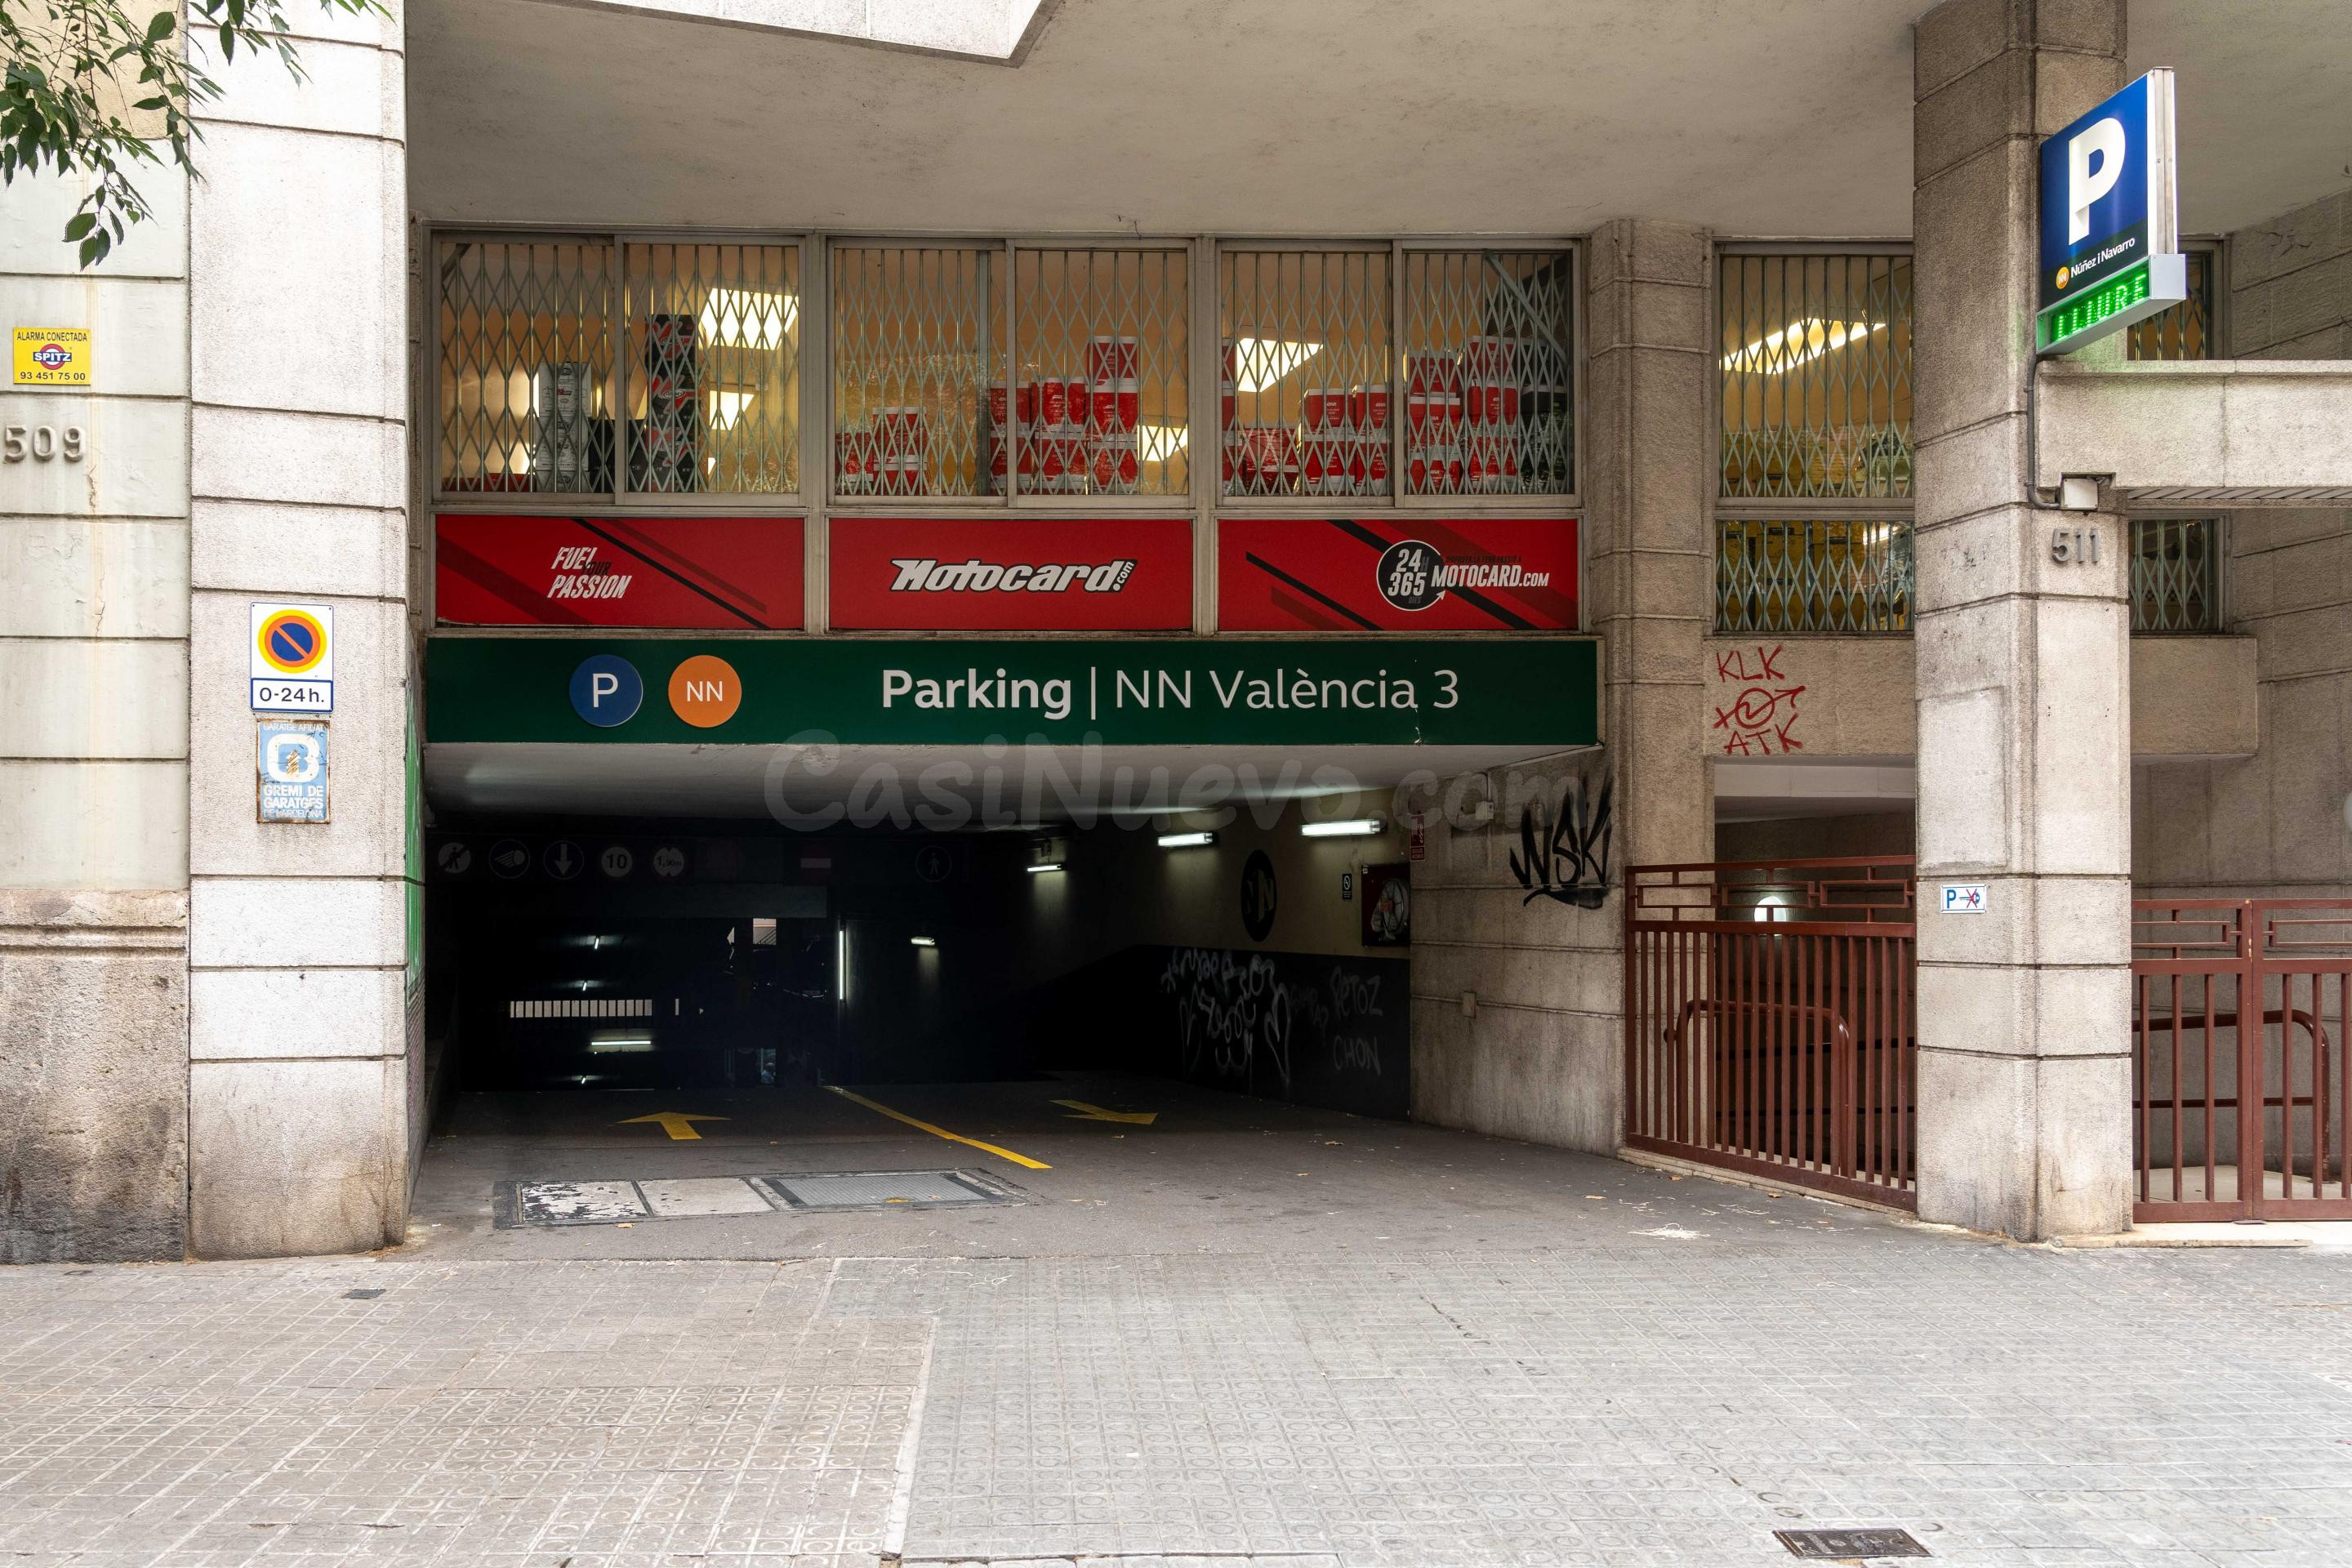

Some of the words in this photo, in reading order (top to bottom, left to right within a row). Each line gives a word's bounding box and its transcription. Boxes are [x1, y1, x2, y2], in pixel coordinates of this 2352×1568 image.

[2069, 118, 2126, 245] P
[2071, 258, 2096, 278] Núñez
[2101, 238, 2136, 262] Navarro
[17, 332, 45, 341] ALARMA
[46, 332, 87, 341] CONECTADA
[34, 352, 71, 362] SPITZ
[20, 372, 33, 380] 93
[36, 372, 54, 380] 451
[59, 372, 70, 381] 75
[74, 372, 86, 381] 00
[4, 424, 86, 462] 509
[551, 546, 598, 569] FUEL
[2051, 528, 2099, 564] 511
[546, 574, 632, 599] PASSION
[1388, 572, 1428, 596] 365
[1716, 644, 1786, 683] KLK
[592, 673, 618, 708] P
[686, 680, 723, 702] NN
[883, 667, 1071, 719] Parking
[1116, 670, 1192, 708] NN
[1209, 668, 1419, 709] València
[1432, 669, 1459, 709] 3
[264, 723, 297, 731] GARATGE
[1723, 713, 1803, 755] ATK
[264, 785, 303, 797] GREMI
[308, 785, 324, 797] DE
[264, 797, 323, 809] GARATGES
[264, 809, 274, 817] DE
[607, 853, 627, 869] 10
[1946, 889, 1957, 909] P
